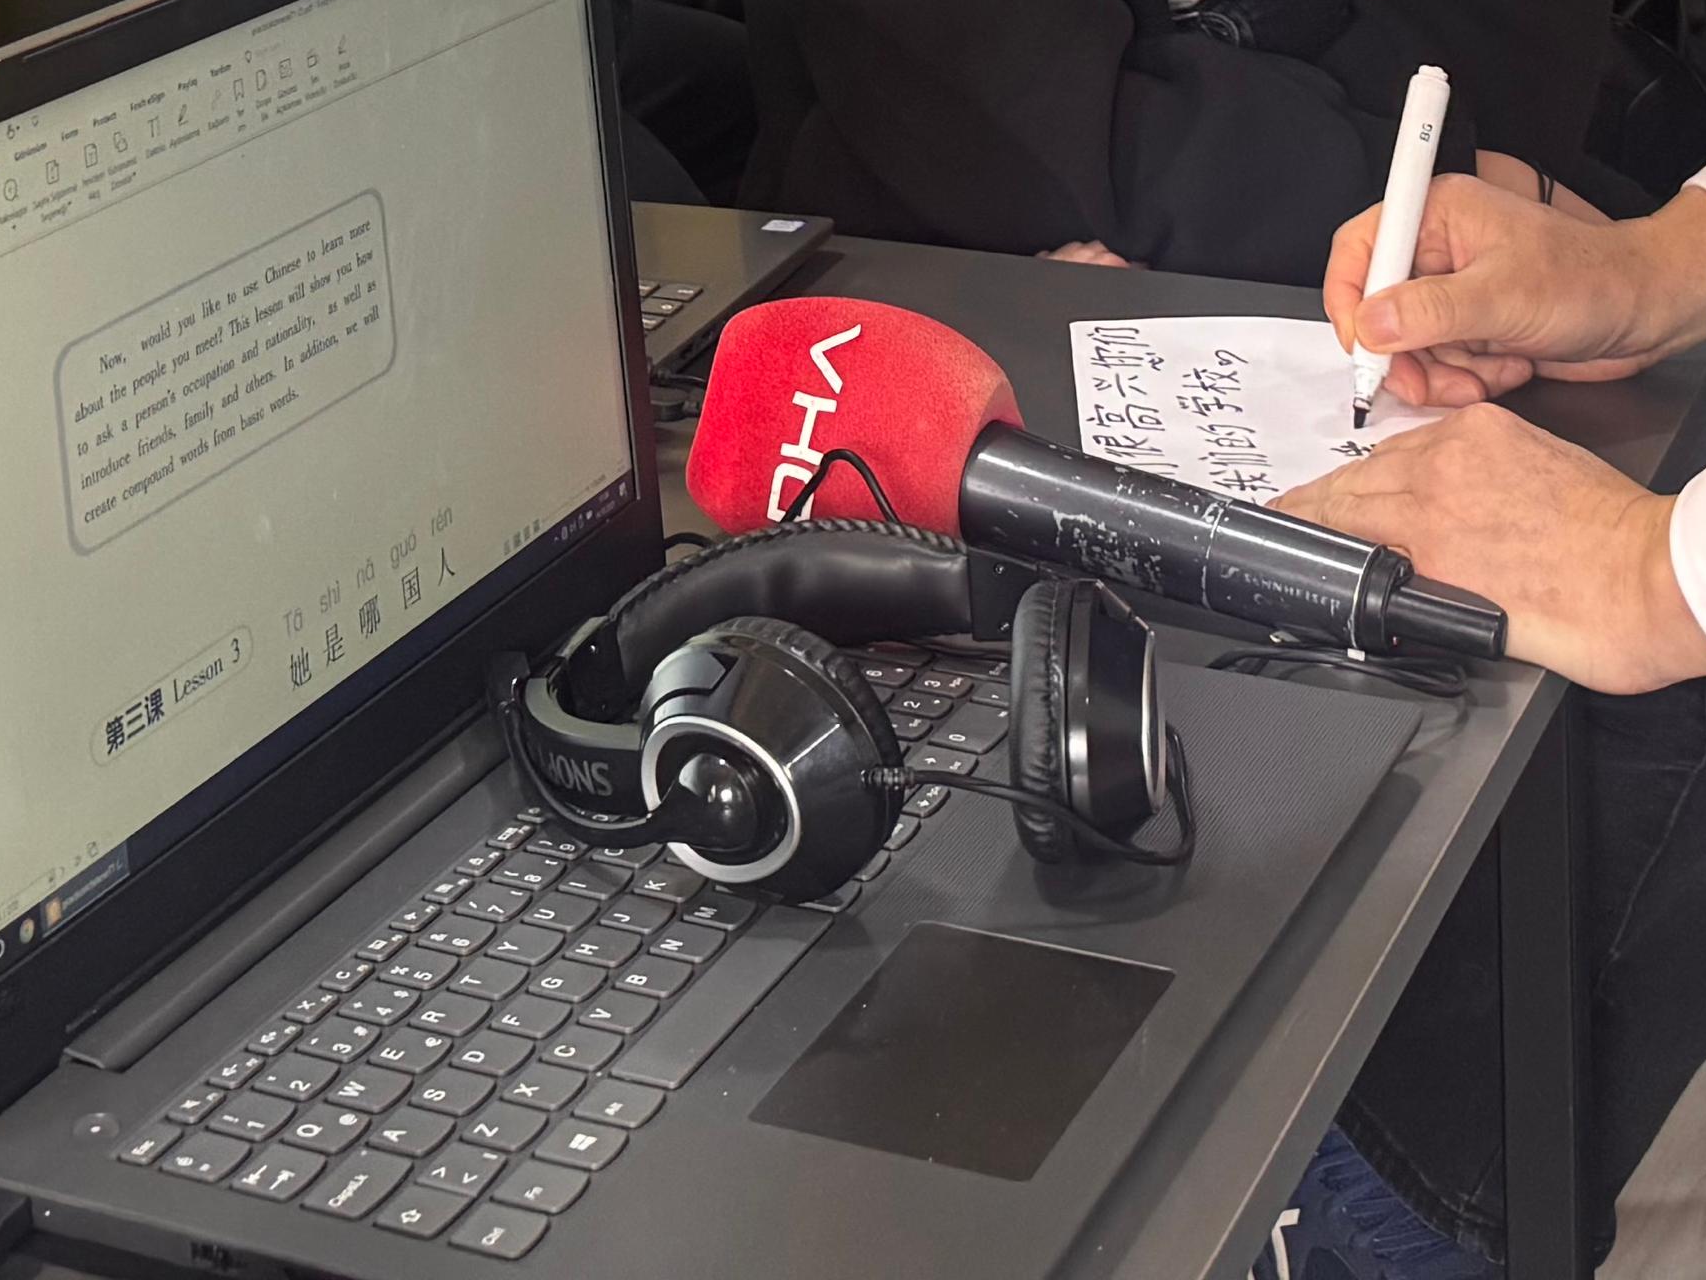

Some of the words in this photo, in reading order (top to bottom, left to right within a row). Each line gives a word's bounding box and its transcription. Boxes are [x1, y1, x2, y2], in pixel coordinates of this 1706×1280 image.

[99, 353, 127, 374] Now,
[141, 321, 171, 351] would
[178, 313, 195, 337] you
[202, 298, 221, 319] like
[227, 293, 237, 306] to
[243, 279, 259, 297] use
[265, 257, 301, 285] Chinese
[306, 249, 316, 264] to
[321, 236, 343, 256] learn
[349, 220, 371, 240] more
[75, 396, 104, 423] about
[110, 384, 127, 404] the
[132, 361, 167, 395] people
[172, 350, 190, 373] you
[195, 327, 223, 355] meet?
[228, 314, 250, 337] This
[255, 298, 283, 323] lesson
[288, 283, 305, 304] will
[310, 273, 331, 293] show
[336, 262, 353, 283] you
[356, 249, 373, 269] how
[78, 441, 89, 456] to
[96, 423, 114, 446] ask
[121, 419, 128, 432] a
[135, 390, 177, 428] person's
[182, 357, 235, 397] occupation
[241, 340, 259, 364] and
[265, 313, 316, 351] nationality,
[328, 301, 338, 316] as
[344, 284, 362, 306] well
[367, 279, 376, 294] as
[81, 451, 131, 490] introduce
[137, 426, 177, 457] friends,
[184, 401, 215, 431] family
[221, 384, 239, 409] and
[245, 368, 276, 394] others.
[284, 355, 294, 373] In
[300, 333, 339, 364] addition,
[346, 321, 358, 337] we
[363, 304, 380, 327] will
[84, 494, 117, 524] create
[122, 456, 175, 501] compound
[179, 438, 210, 467] words
[213, 425, 236, 447] from
[240, 406, 265, 431] basic
[270, 387, 300, 414] words.
[105, 687, 166, 756] 第三课
[173, 653, 224, 705] Lesson
[230, 637, 242, 665] 3
[559, 842, 576, 852] 9
[524, 873, 542, 883] 8
[644, 879, 667, 891] K
[487, 904, 505, 914] 7
[533, 908, 556, 920] U
[693, 905, 718, 919] M
[613, 912, 631, 923] J
[452, 937, 470, 947] 6
[496, 941, 519, 951] Y
[659, 938, 684, 951] N
[574, 943, 599, 956] H
[413, 971, 433, 981] 5
[459, 974, 482, 984] T
[624, 974, 648, 986] B
[540, 977, 564, 989] G
[376, 1006, 393, 1016] 4
[420, 1010, 446, 1023] R
[588, 1007, 612, 1019] V
[501, 1014, 520, 1026] F
[332, 1043, 352, 1054] 3
[379, 1047, 405, 1061] E
[553, 1045, 576, 1058] C
[461, 1050, 485, 1063] D
[289, 1080, 311, 1092] 2
[337, 1080, 366, 1097] W
[513, 1082, 540, 1098] X
[422, 1088, 446, 1102] S
[296, 1123, 323, 1138] Q
[382, 1130, 407, 1143] A
[473, 1123, 499, 1138] Z
